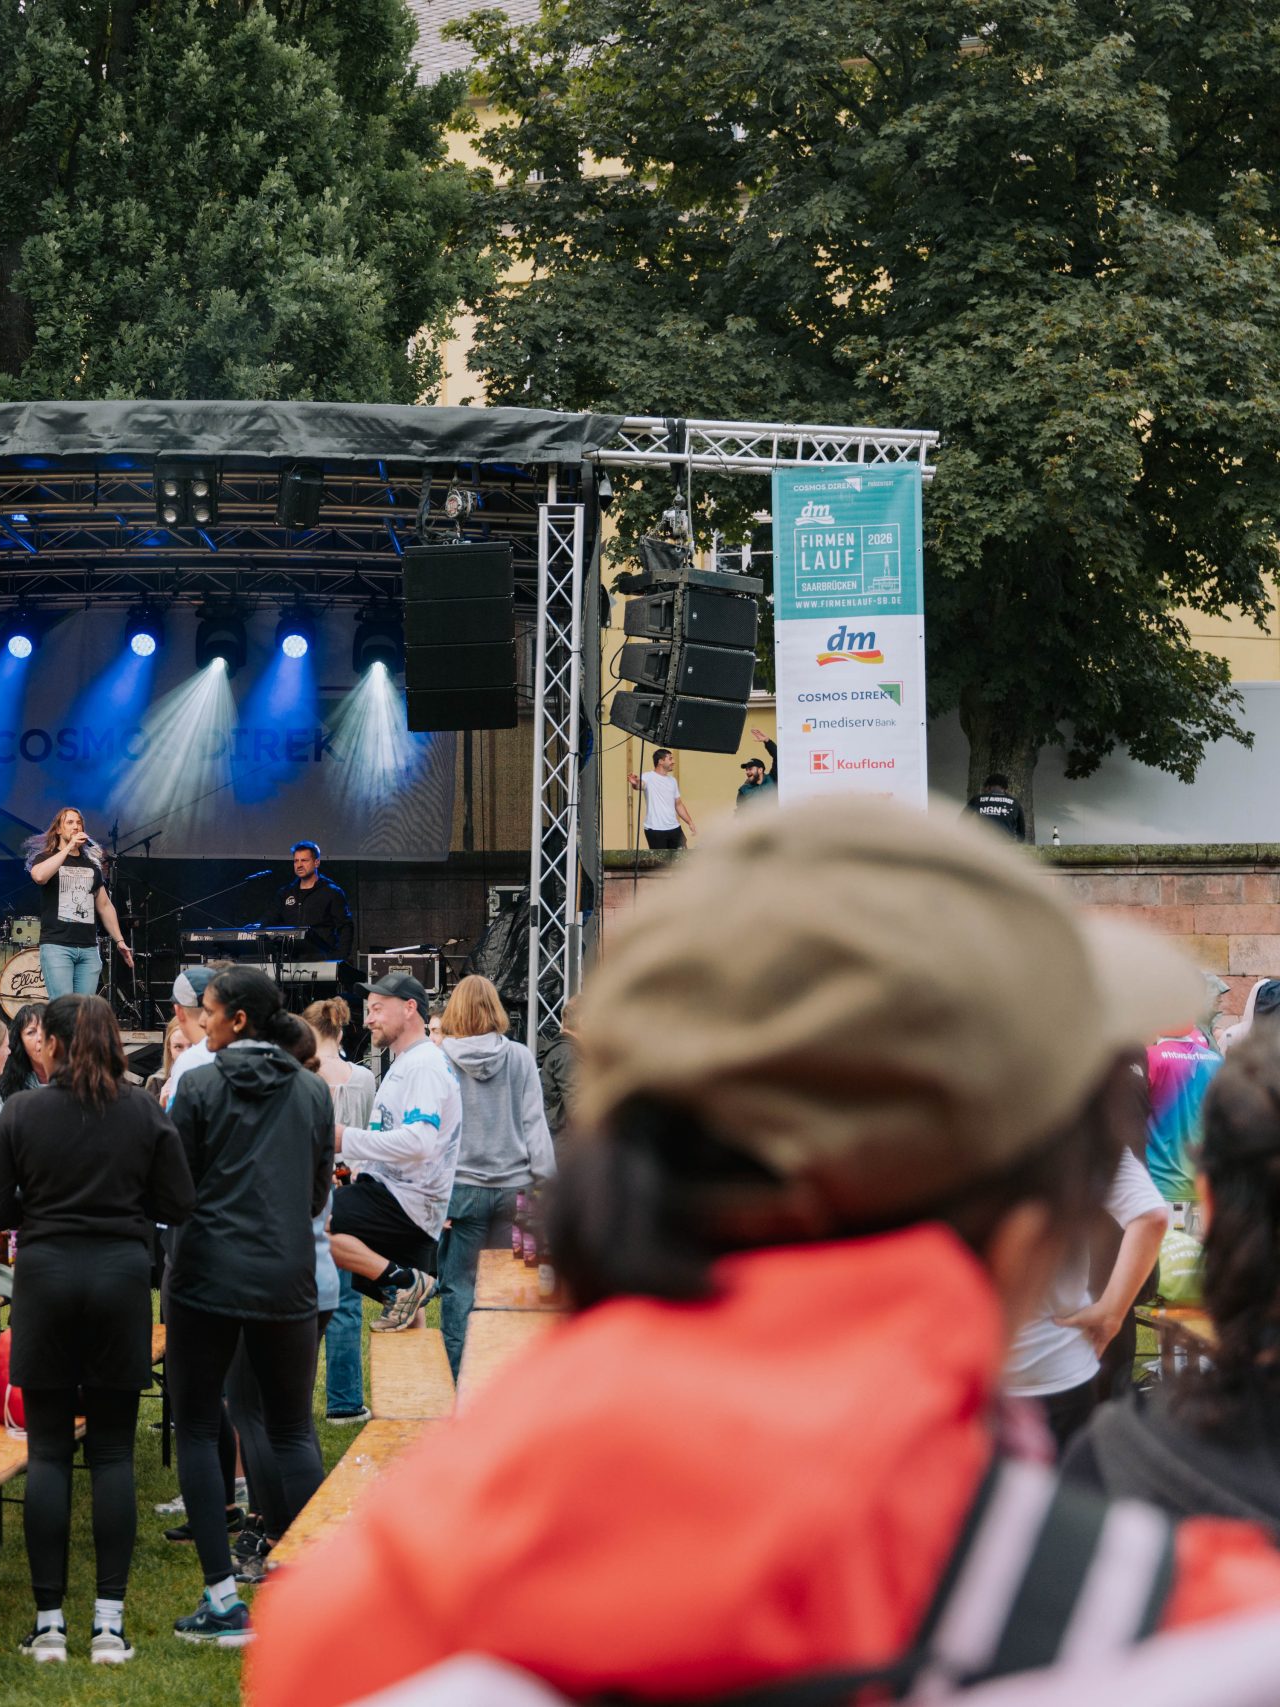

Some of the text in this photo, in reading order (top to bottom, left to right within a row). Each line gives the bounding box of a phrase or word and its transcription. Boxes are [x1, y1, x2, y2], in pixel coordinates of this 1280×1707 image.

[793, 484, 826, 492] COSMOS
[800, 500, 830, 517] dm
[801, 533, 854, 548] FIRMEN
[867, 533, 893, 545] 2026
[801, 549, 854, 571] LAUF
[801, 580, 857, 592] SAARBRÜCKEN
[795, 596, 902, 609] WWW.FIRMENLAUF-SB.DE
[826, 625, 876, 651] dm
[797, 690, 895, 703] COSMOS DIREKT
[819, 717, 896, 729] mediserv Bank
[199, 727, 348, 764] DIREK
[837, 758, 895, 769] Kaufland
[979, 806, 1002, 814] NGN
[237, 932, 257, 941] KORG
